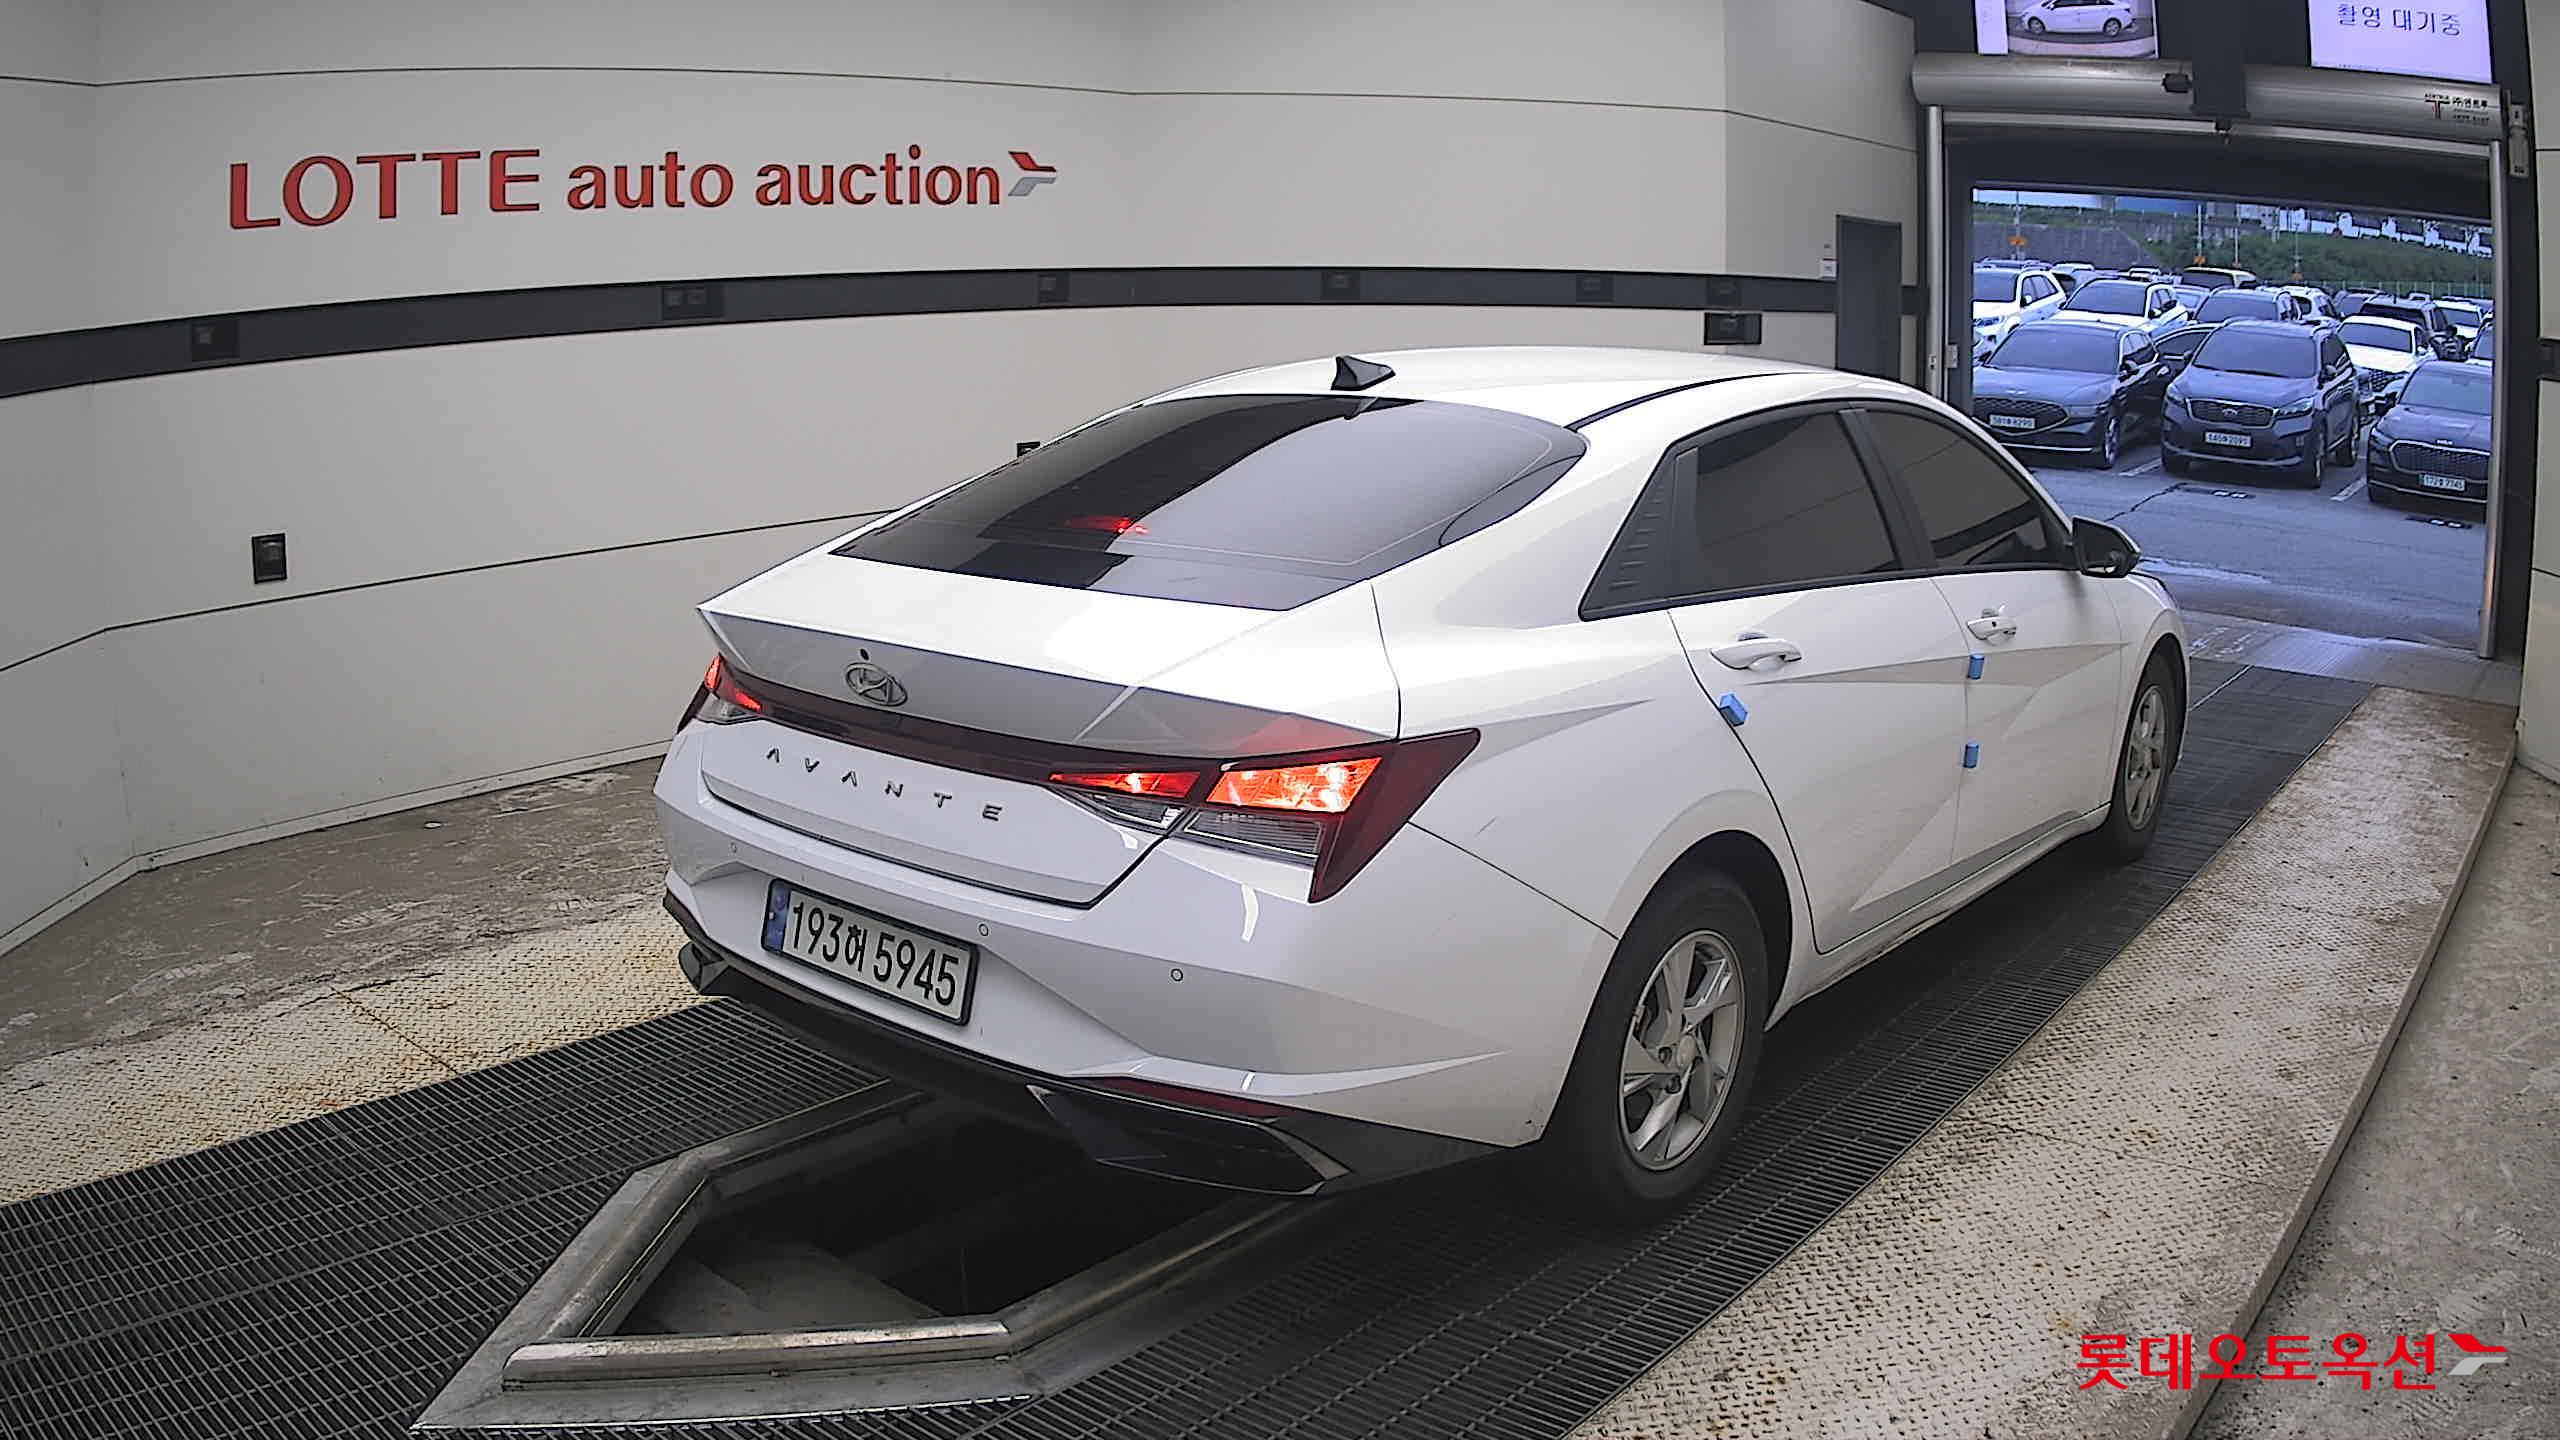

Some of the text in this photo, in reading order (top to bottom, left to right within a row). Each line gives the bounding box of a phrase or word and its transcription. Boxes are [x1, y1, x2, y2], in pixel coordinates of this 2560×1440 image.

[2337, 3, 2462, 37] 촬영 대기중
[229, 145, 1004, 230] LOTTE auto auction
[765, 745, 1004, 822] AVANTE
[792, 901, 960, 1007] 193허 5945
